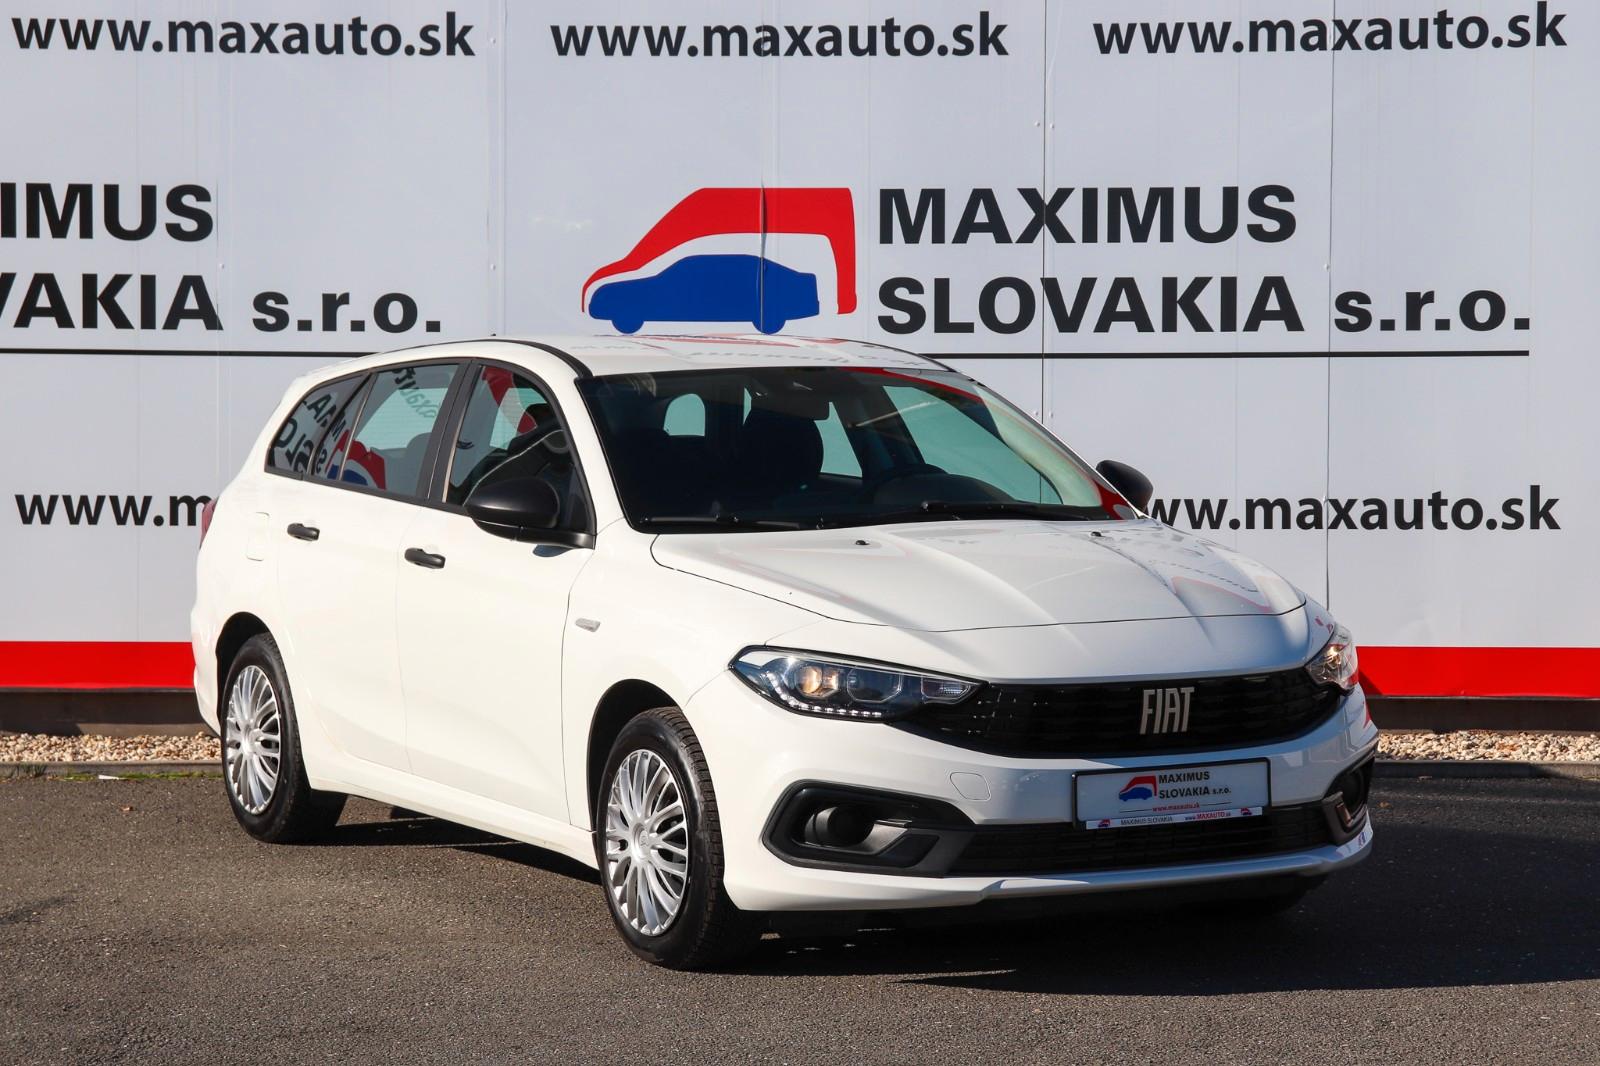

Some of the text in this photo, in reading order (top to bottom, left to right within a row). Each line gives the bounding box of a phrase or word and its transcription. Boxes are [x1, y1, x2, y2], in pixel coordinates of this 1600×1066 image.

[12, 11, 475, 57] www.maxauto.sk
[551, 10, 1009, 57] www.maxauto.sk
[1093, 1, 1567, 55] www.maxauto.sk
[879, 184, 1297, 245] MAXIMUS
[252, 291, 441, 333] s.r.o.
[877, 276, 1530, 335] SLOVAKIA s.r.o.
[1140, 687, 1195, 735] FIAT
[1158, 771, 1210, 784] MAXIMUS
[1158, 786, 1232, 799] SLOVAKIA s.r.o.
